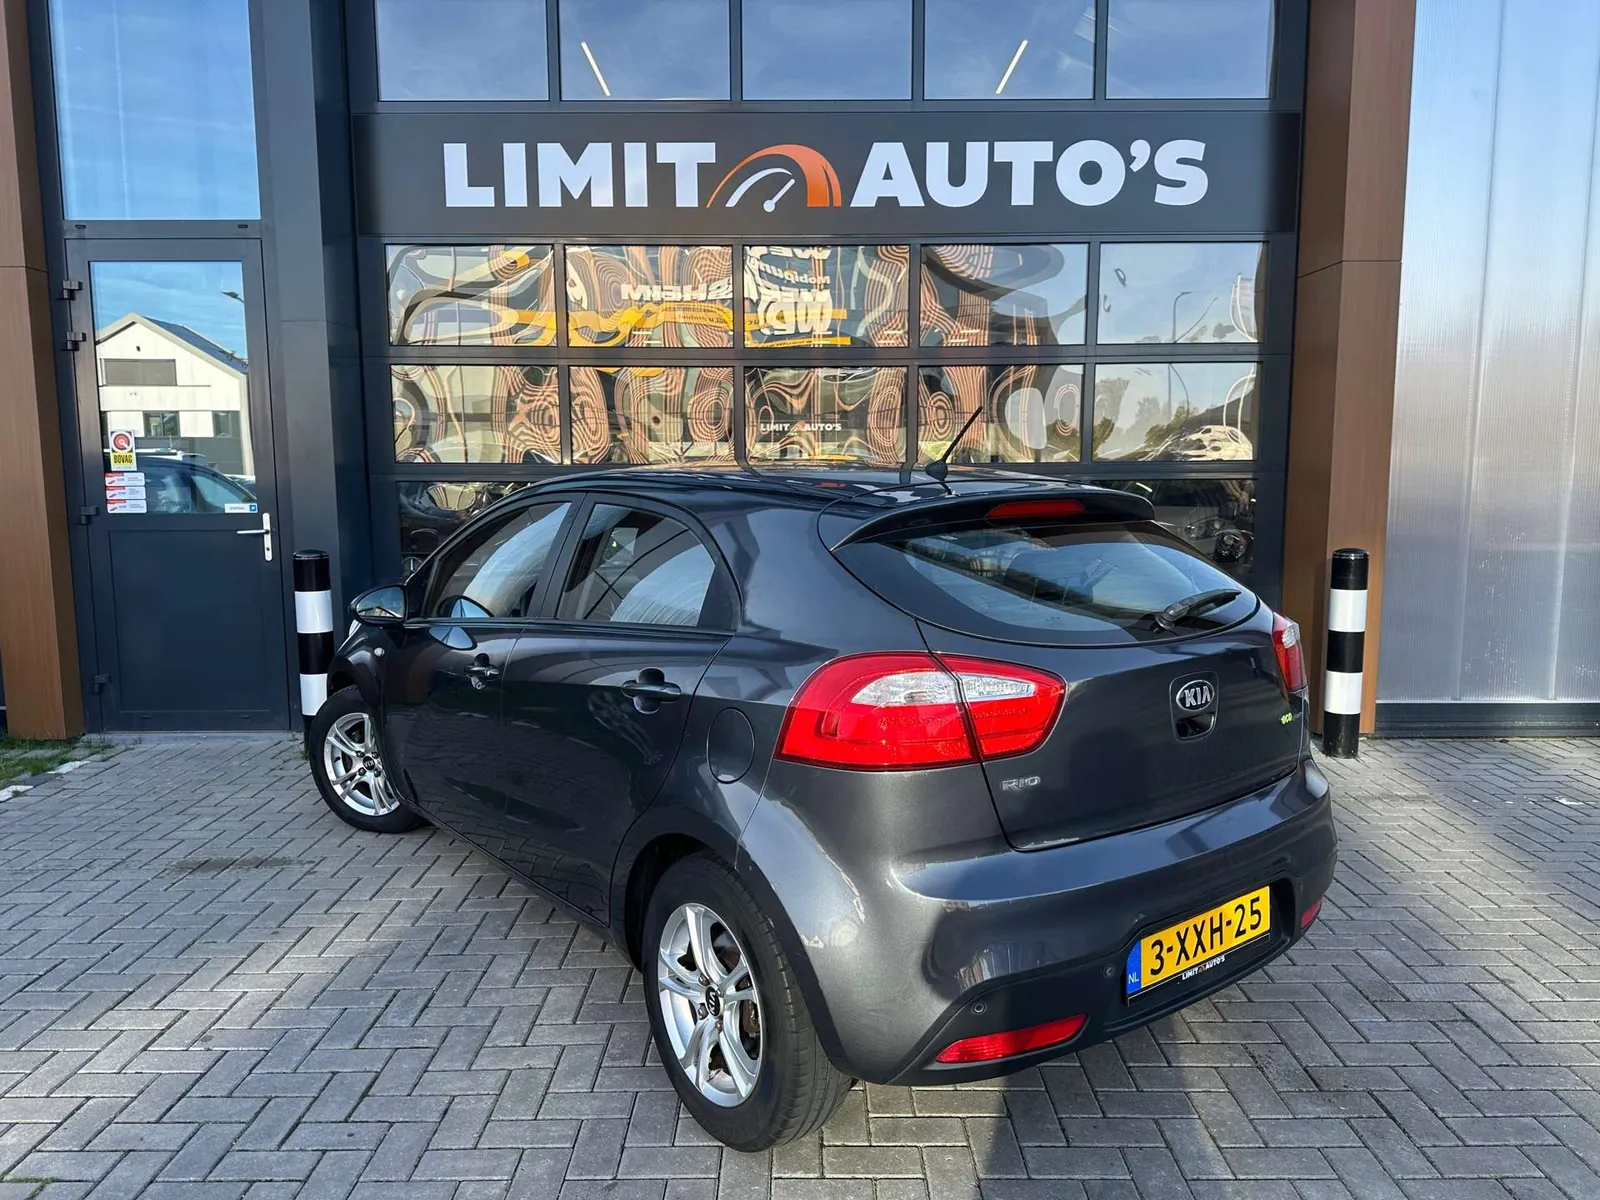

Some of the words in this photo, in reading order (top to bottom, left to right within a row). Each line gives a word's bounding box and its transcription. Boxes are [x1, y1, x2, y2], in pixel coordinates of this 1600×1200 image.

[443, 142, 716, 207] LIMIT
[850, 139, 1209, 207] AUTO'S
[760, 423, 790, 431] LIMIT
[804, 423, 842, 431] AUTO'S
[114, 454, 133, 465] BOVAG
[1185, 689, 1211, 707] KIA
[1002, 776, 1042, 791] RIO
[1150, 896, 1261, 975] 3-XXH-25
[1128, 973, 1139, 985] NL
[1182, 968, 1199, 980] LIMIT
